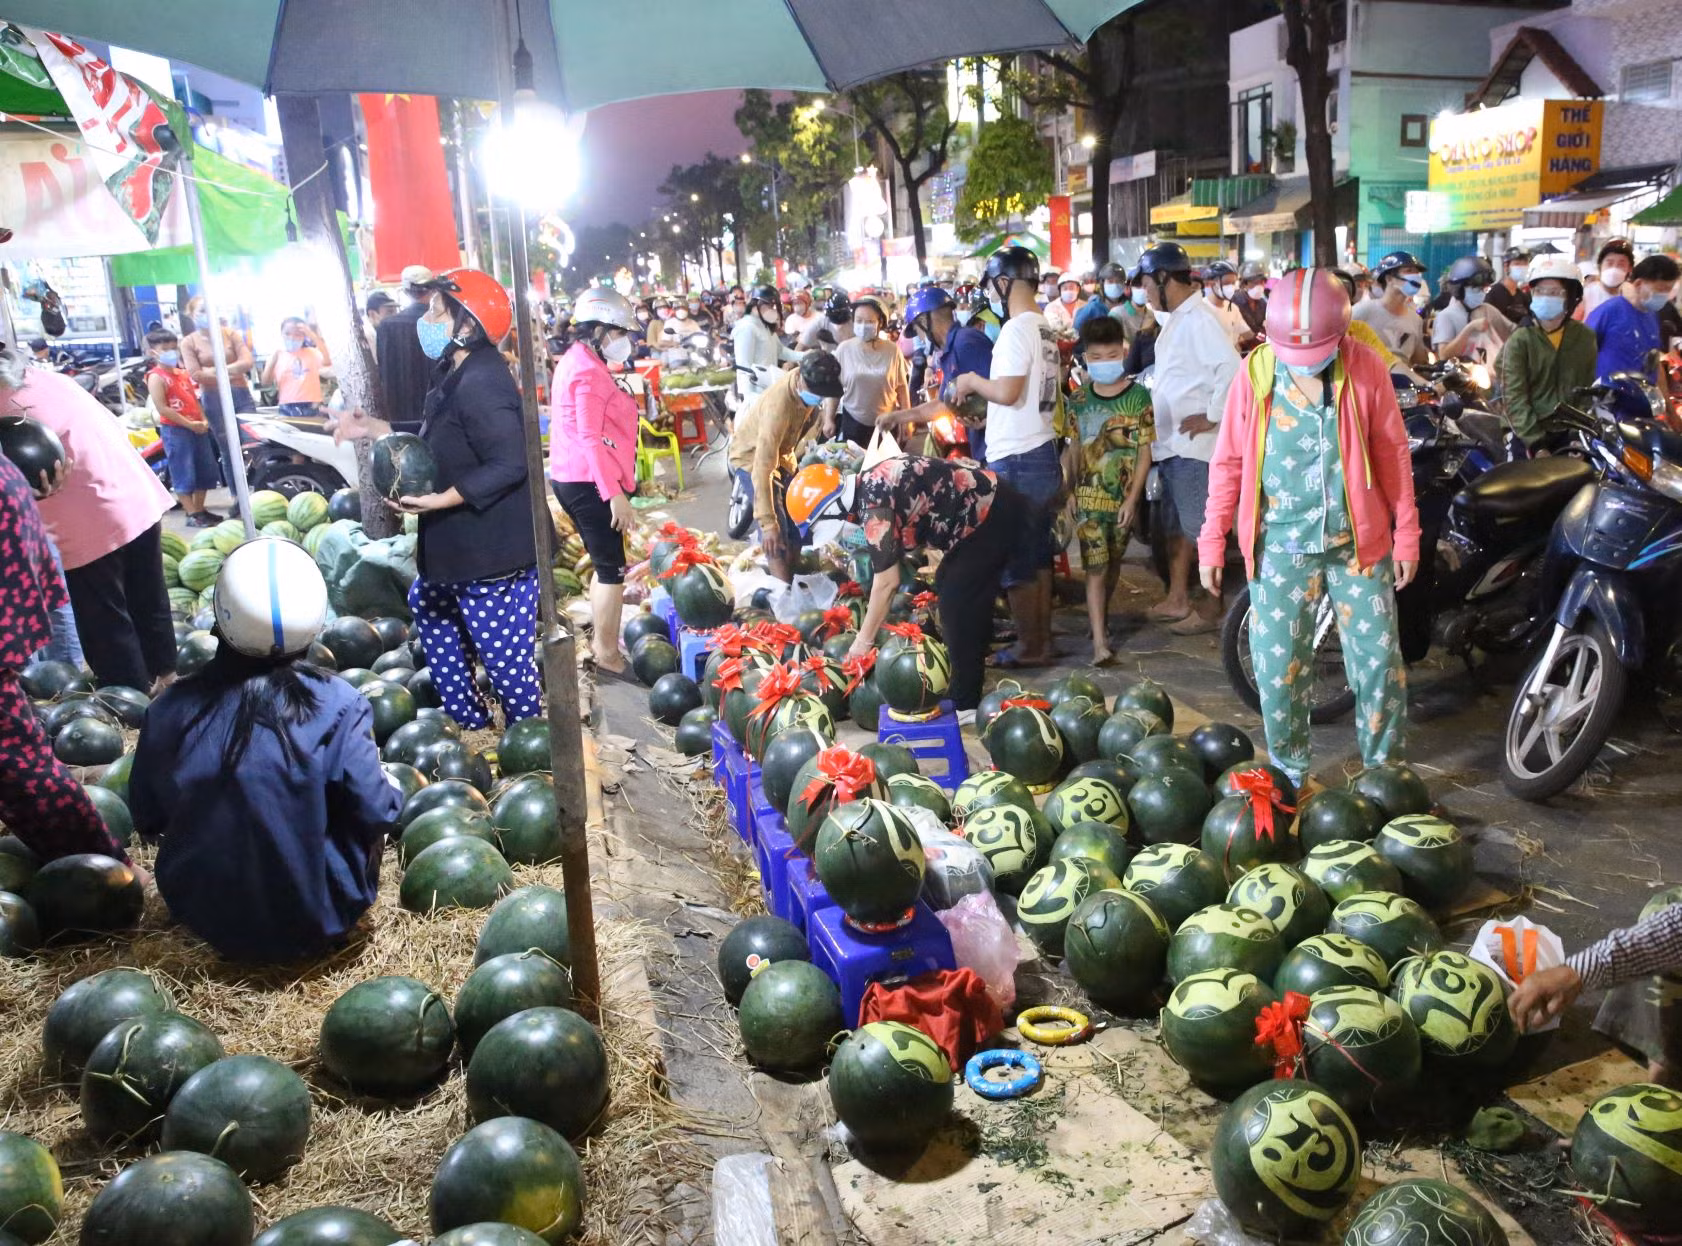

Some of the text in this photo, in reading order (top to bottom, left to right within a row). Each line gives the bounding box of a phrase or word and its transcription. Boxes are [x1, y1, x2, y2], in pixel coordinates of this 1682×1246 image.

[1561, 103, 1591, 123] THẾ
[1556, 127, 1590, 148] GIỚI
[1549, 154, 1591, 173] HÀNG
